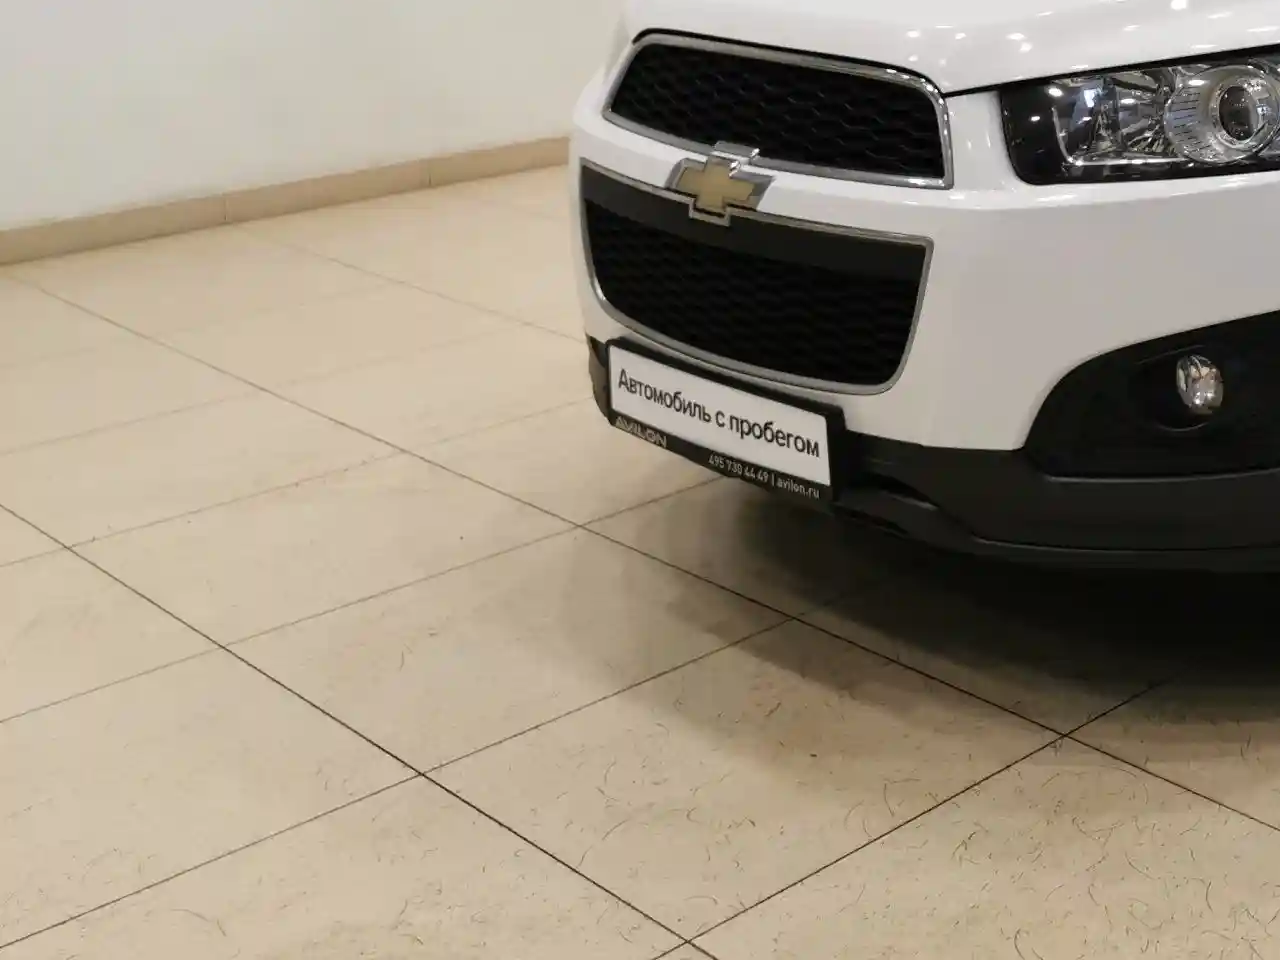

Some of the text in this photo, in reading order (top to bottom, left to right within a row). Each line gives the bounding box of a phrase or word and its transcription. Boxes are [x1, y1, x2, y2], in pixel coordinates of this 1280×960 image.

[618, 369, 820, 458] Автомобиль с пробегом
[708, 454, 725, 469] 495
[777, 478, 820, 499] avilon.ru
